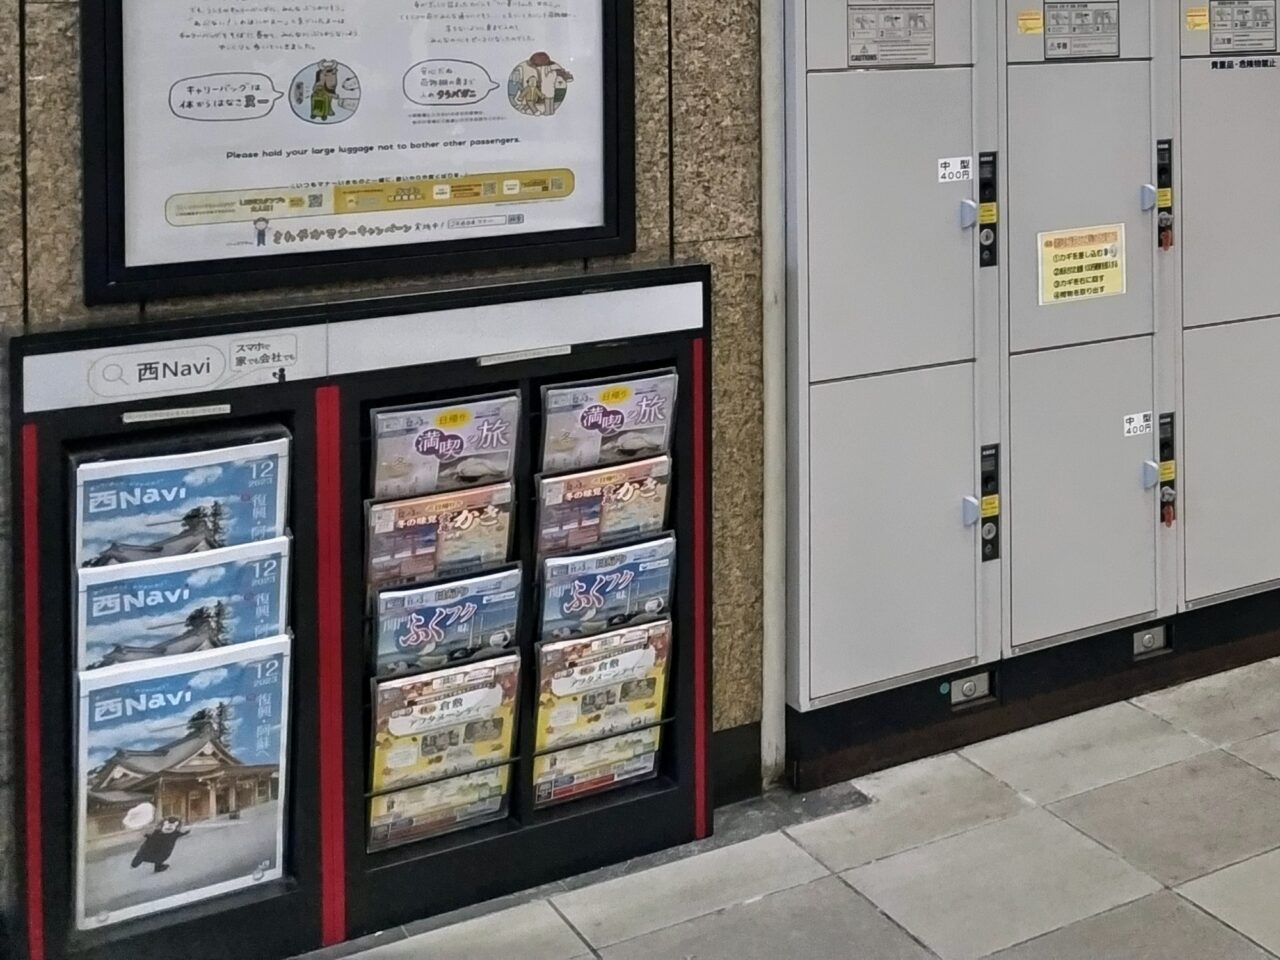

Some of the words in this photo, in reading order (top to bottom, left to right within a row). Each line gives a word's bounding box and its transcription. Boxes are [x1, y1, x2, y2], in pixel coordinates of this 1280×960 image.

[226, 150, 258, 160] Please
[262, 149, 282, 158] hold
[285, 148, 308, 159] your
[311, 146, 335, 157] large
[338, 143, 374, 155] luggage
[378, 143, 394, 151] not
[397, 142, 407, 150] to
[410, 140, 439, 150] bother
[443, 139, 466, 148] other
[940, 170, 970, 180] 400円
[137, 357, 211, 382] 西Navi
[1126, 423, 1152, 434] 400円
[251, 460, 274, 479] 12
[89, 486, 186, 513] 西Navi
[252, 560, 277, 578] 12
[93, 588, 190, 617] 西Navi
[255, 659, 279, 679] 12
[94, 690, 192, 722] 西Navi
